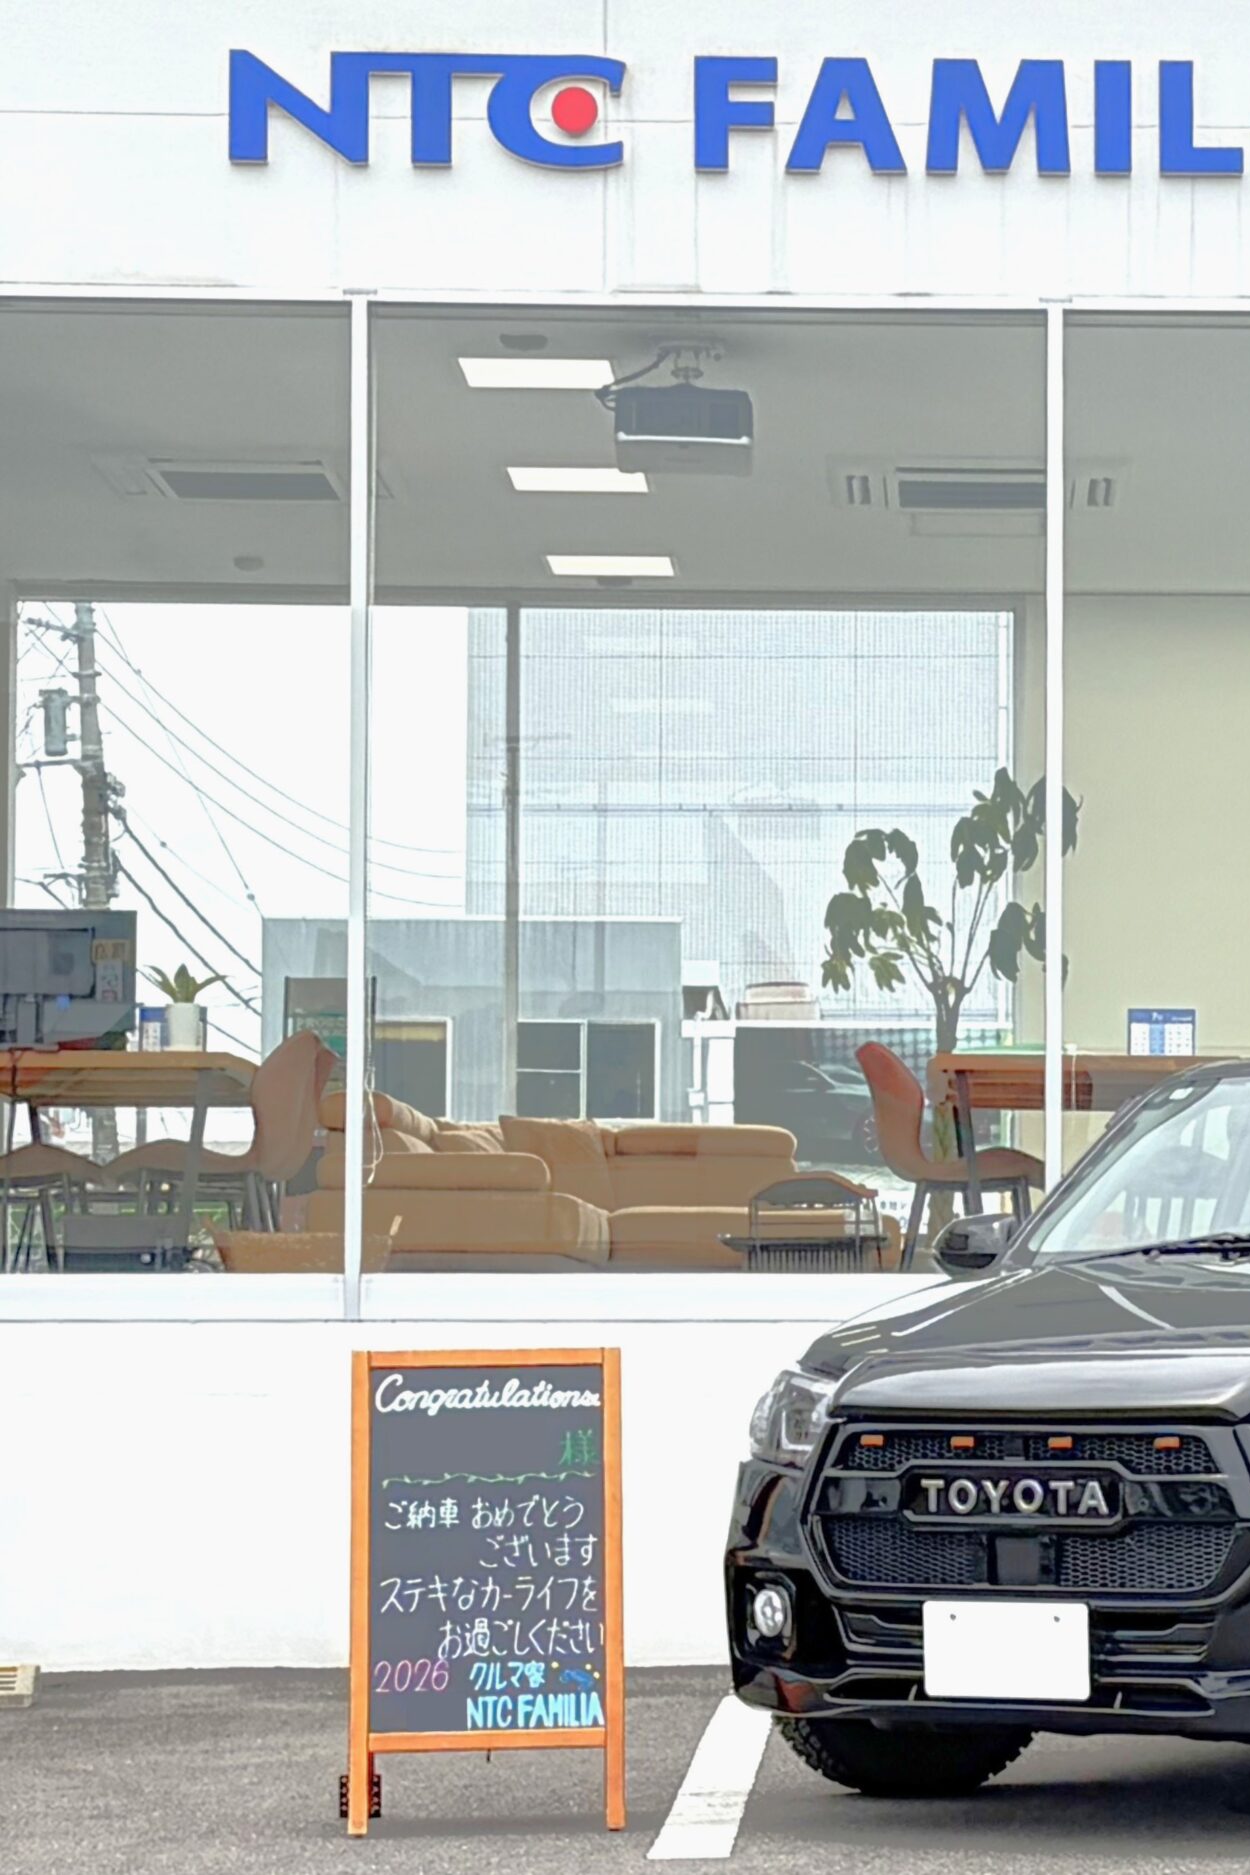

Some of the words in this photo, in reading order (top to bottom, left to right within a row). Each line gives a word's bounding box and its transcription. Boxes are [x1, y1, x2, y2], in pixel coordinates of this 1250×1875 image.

[229, 48, 627, 169] NTC
[375, 1373, 601, 1416] Congratulations
[558, 1428, 601, 1467] 様
[384, 1497, 460, 1530] ご納車
[470, 1494, 584, 1529] おめでとう
[920, 1478, 1109, 1515] TOYOTA
[479, 1533, 598, 1568] ございます
[379, 1575, 598, 1613] ステキなカーライフを
[437, 1617, 605, 1660] お過ごしください
[374, 1658, 449, 1693] 2026
[466, 1696, 513, 1729] NTC
[517, 1691, 605, 1728] FAMILIA
